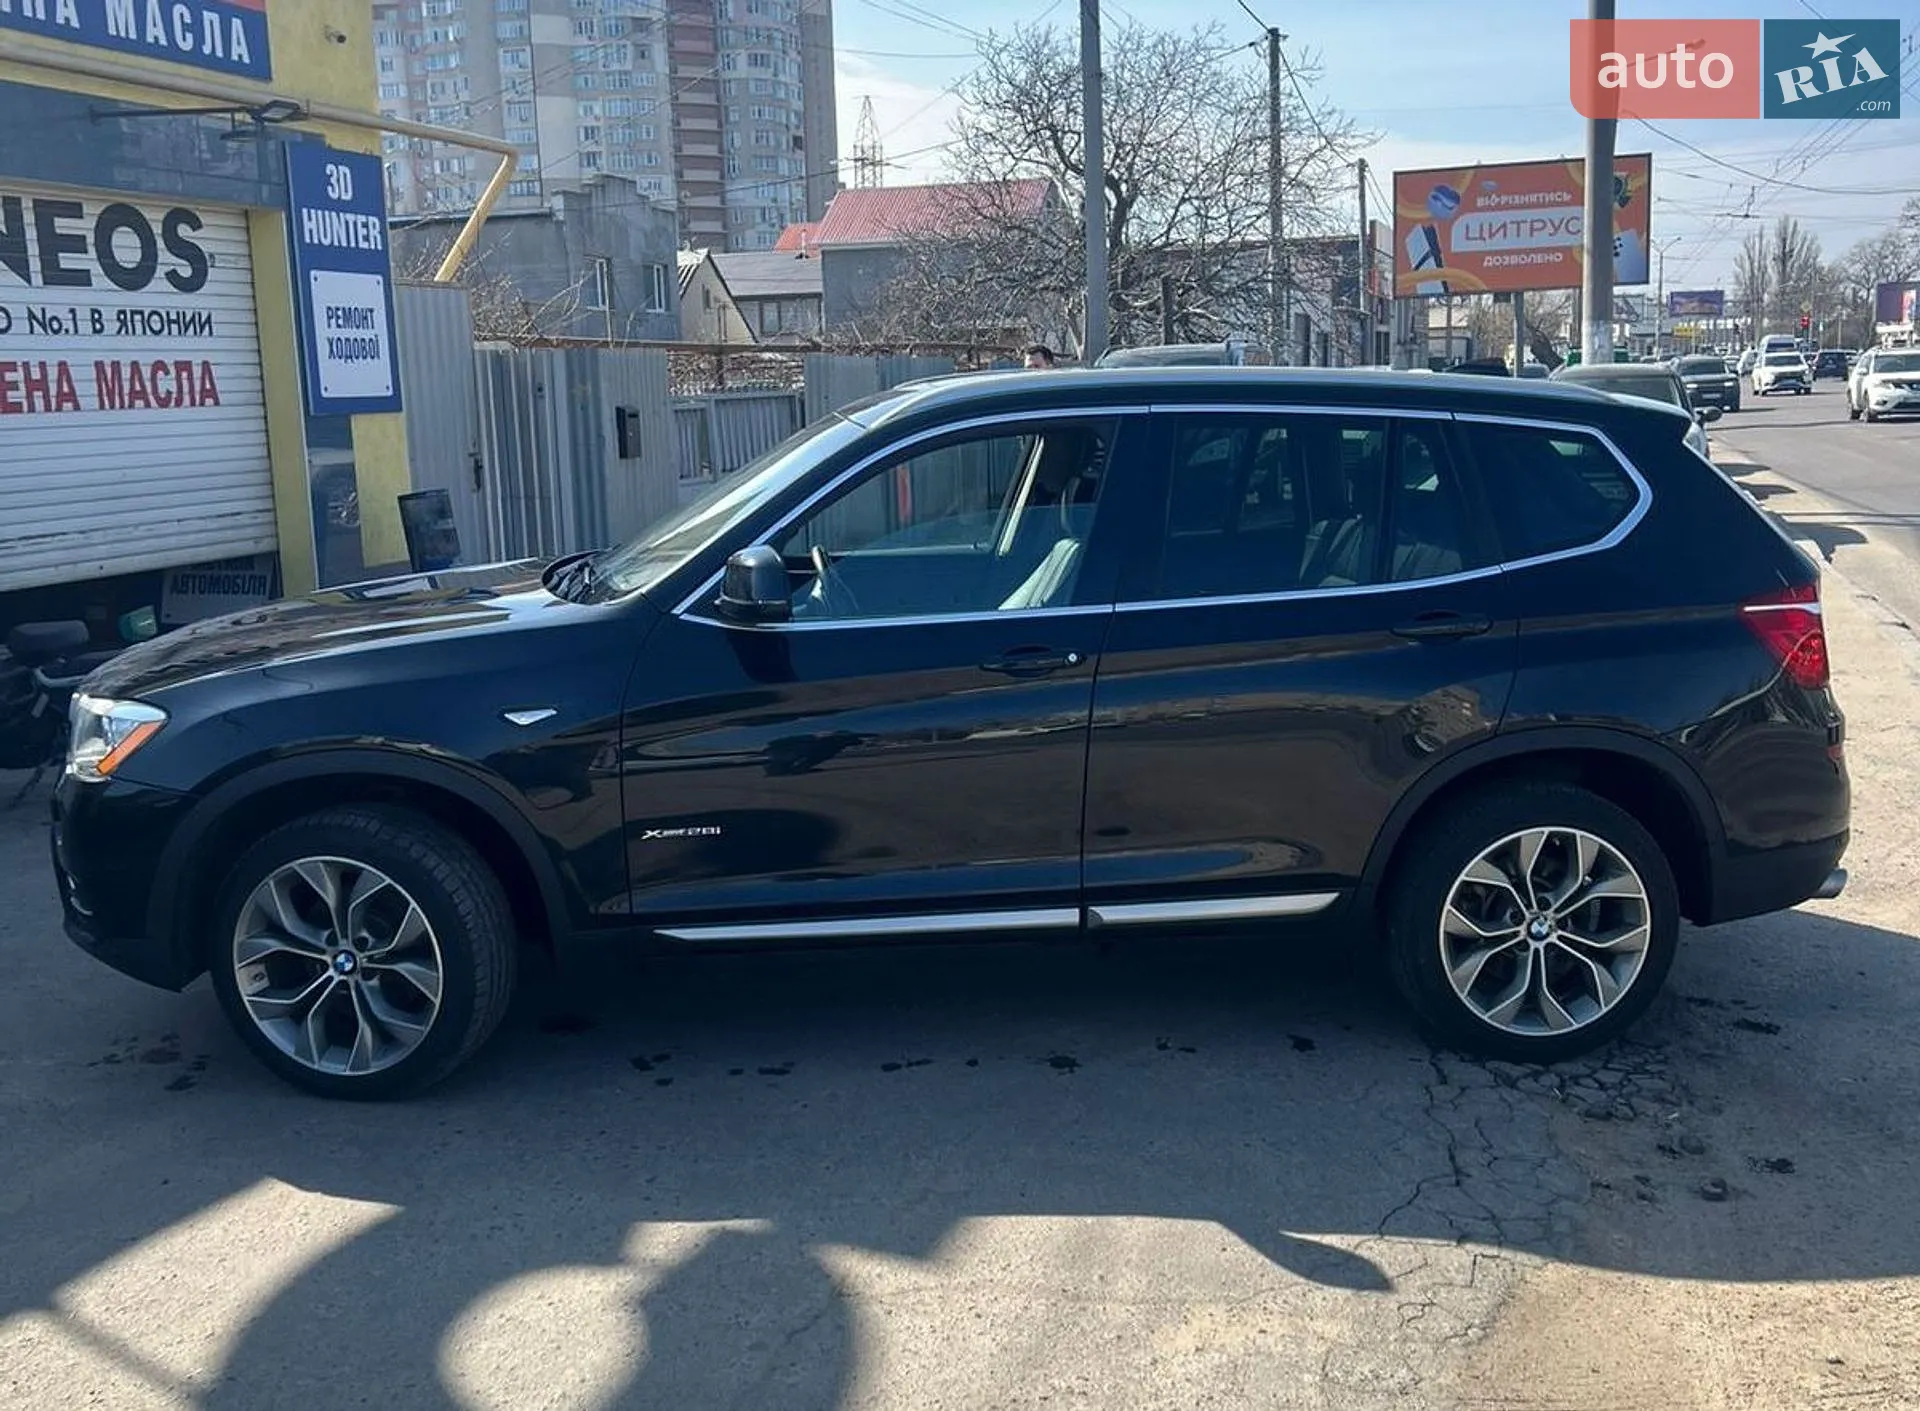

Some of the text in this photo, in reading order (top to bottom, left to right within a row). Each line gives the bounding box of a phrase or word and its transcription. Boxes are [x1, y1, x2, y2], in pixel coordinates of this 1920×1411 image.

[104, 0, 251, 64] МАСЛА
[325, 163, 353, 200] 3D
[302, 208, 382, 250] HUNTER
[1465, 216, 1582, 244] ЦИТРУС
[1483, 252, 1563, 267] ДОЗВОЛЕНО
[27, 306, 78, 335] No.1
[91, 308, 104, 334] В
[116, 309, 214, 336] ЯПОНИИ
[326, 306, 375, 330] РЕМОНТ
[327, 335, 380, 363] ХОДОВОЇ
[94, 360, 220, 409] МАСЛА
